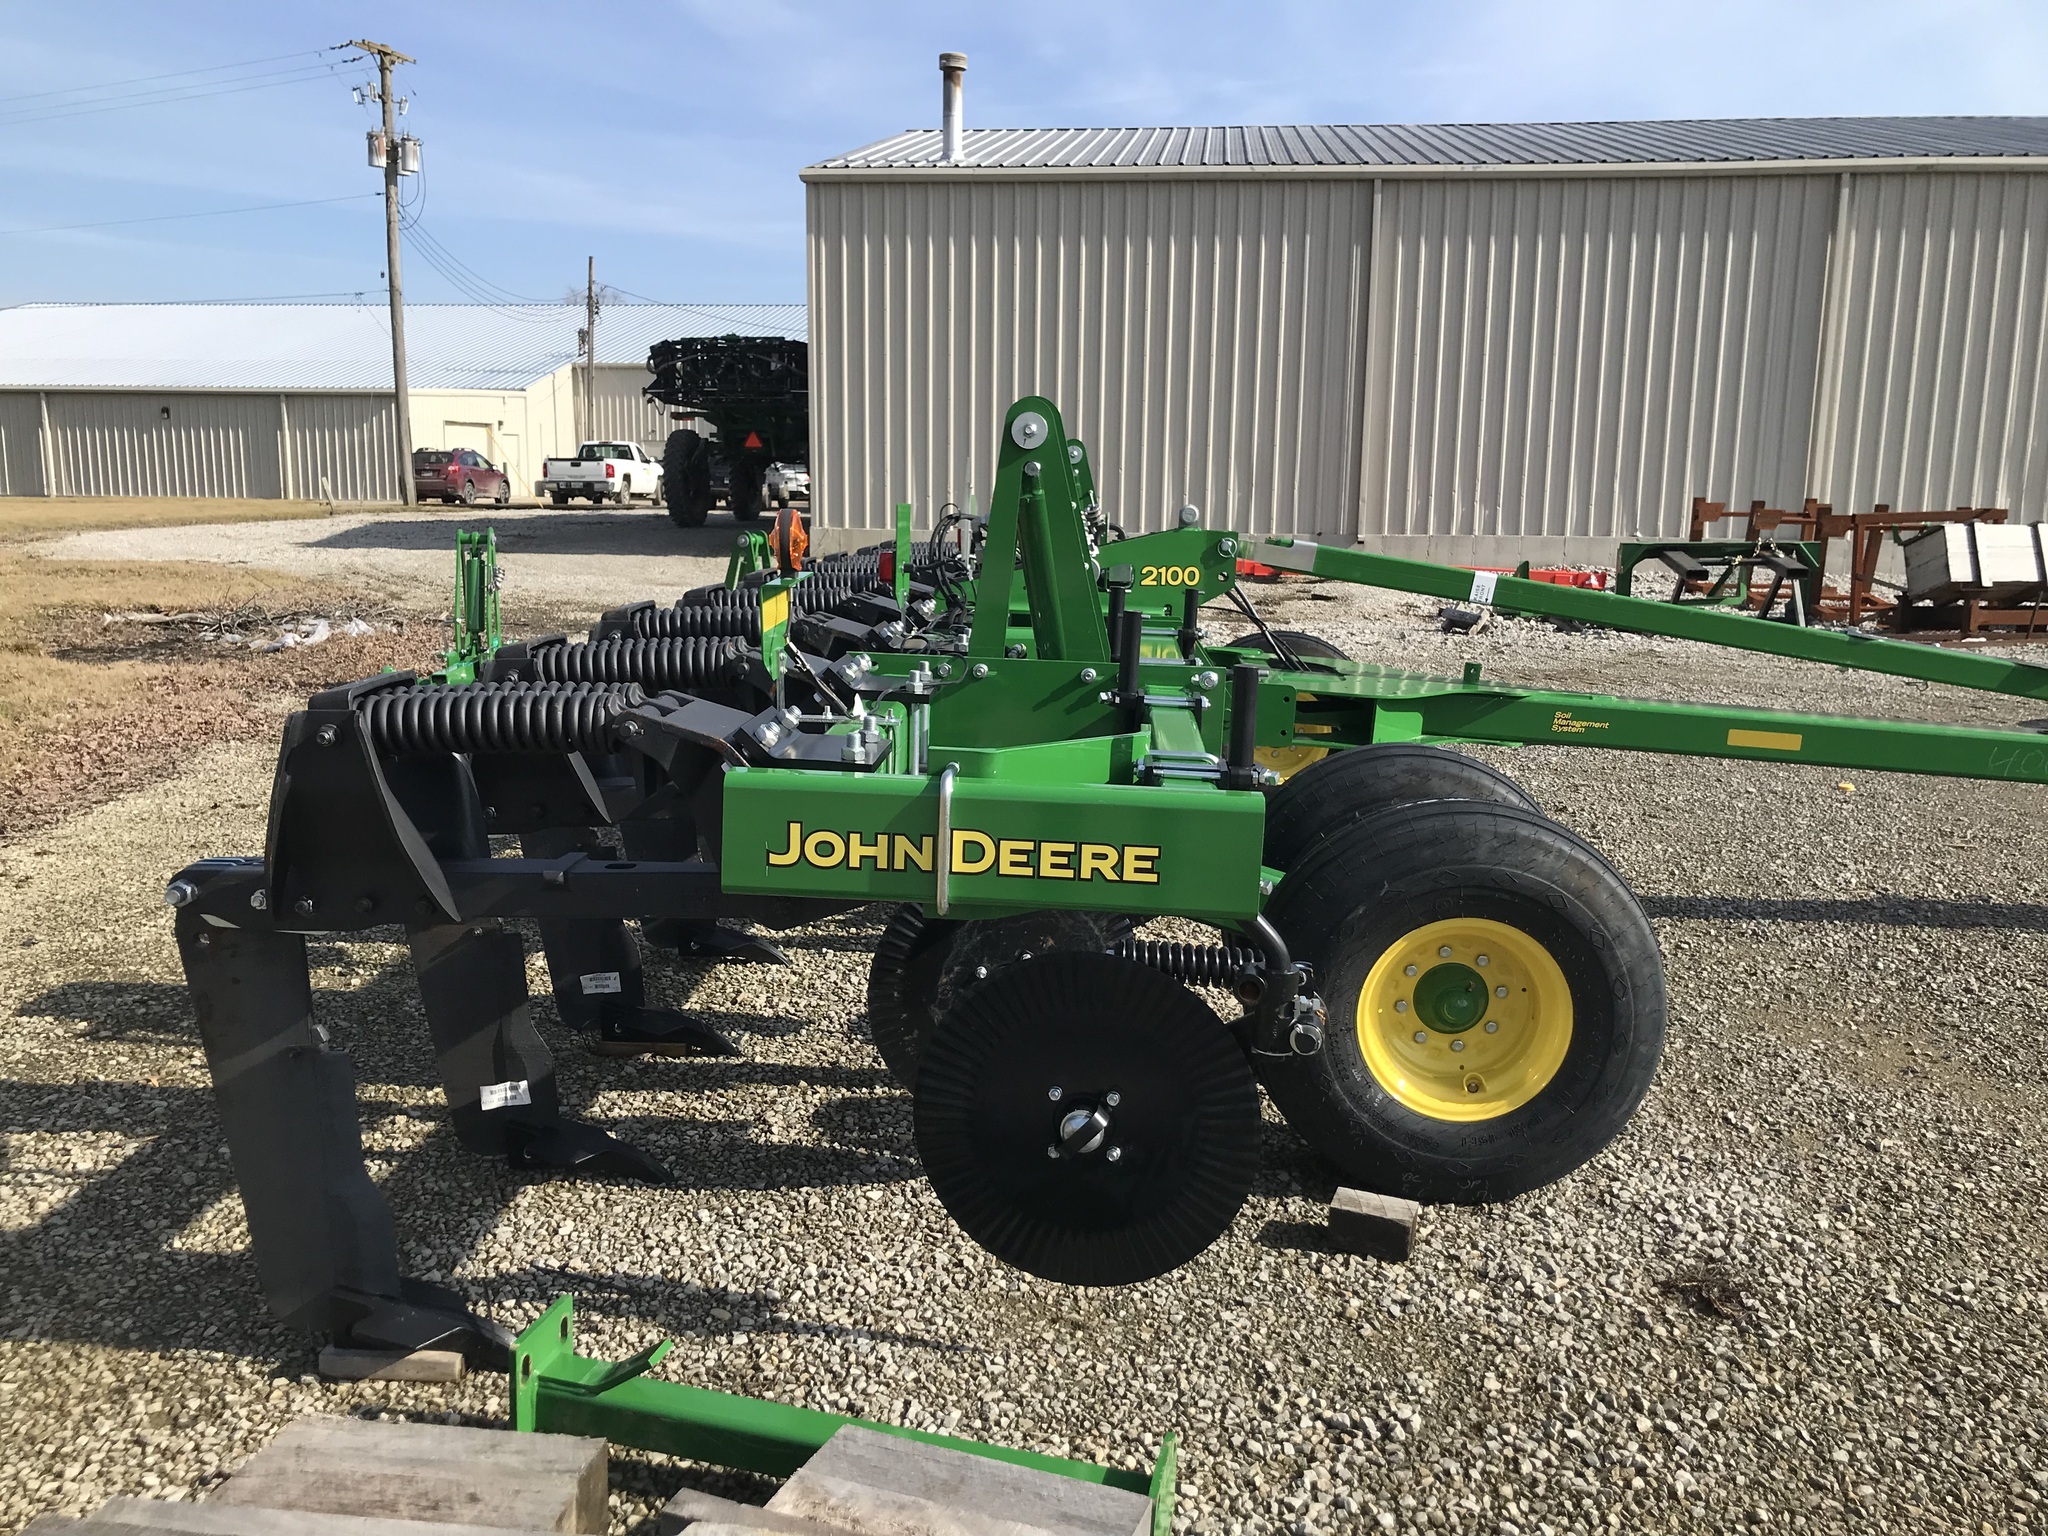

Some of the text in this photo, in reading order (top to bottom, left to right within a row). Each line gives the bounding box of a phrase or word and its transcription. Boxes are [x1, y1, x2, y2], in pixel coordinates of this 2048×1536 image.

[1140, 565, 1201, 586] 2100
[1554, 711, 1572, 719] Soil
[1551, 724, 1585, 733] System
[1553, 718, 1609, 729] Management
[766, 821, 1161, 885] JOHN DEERE
